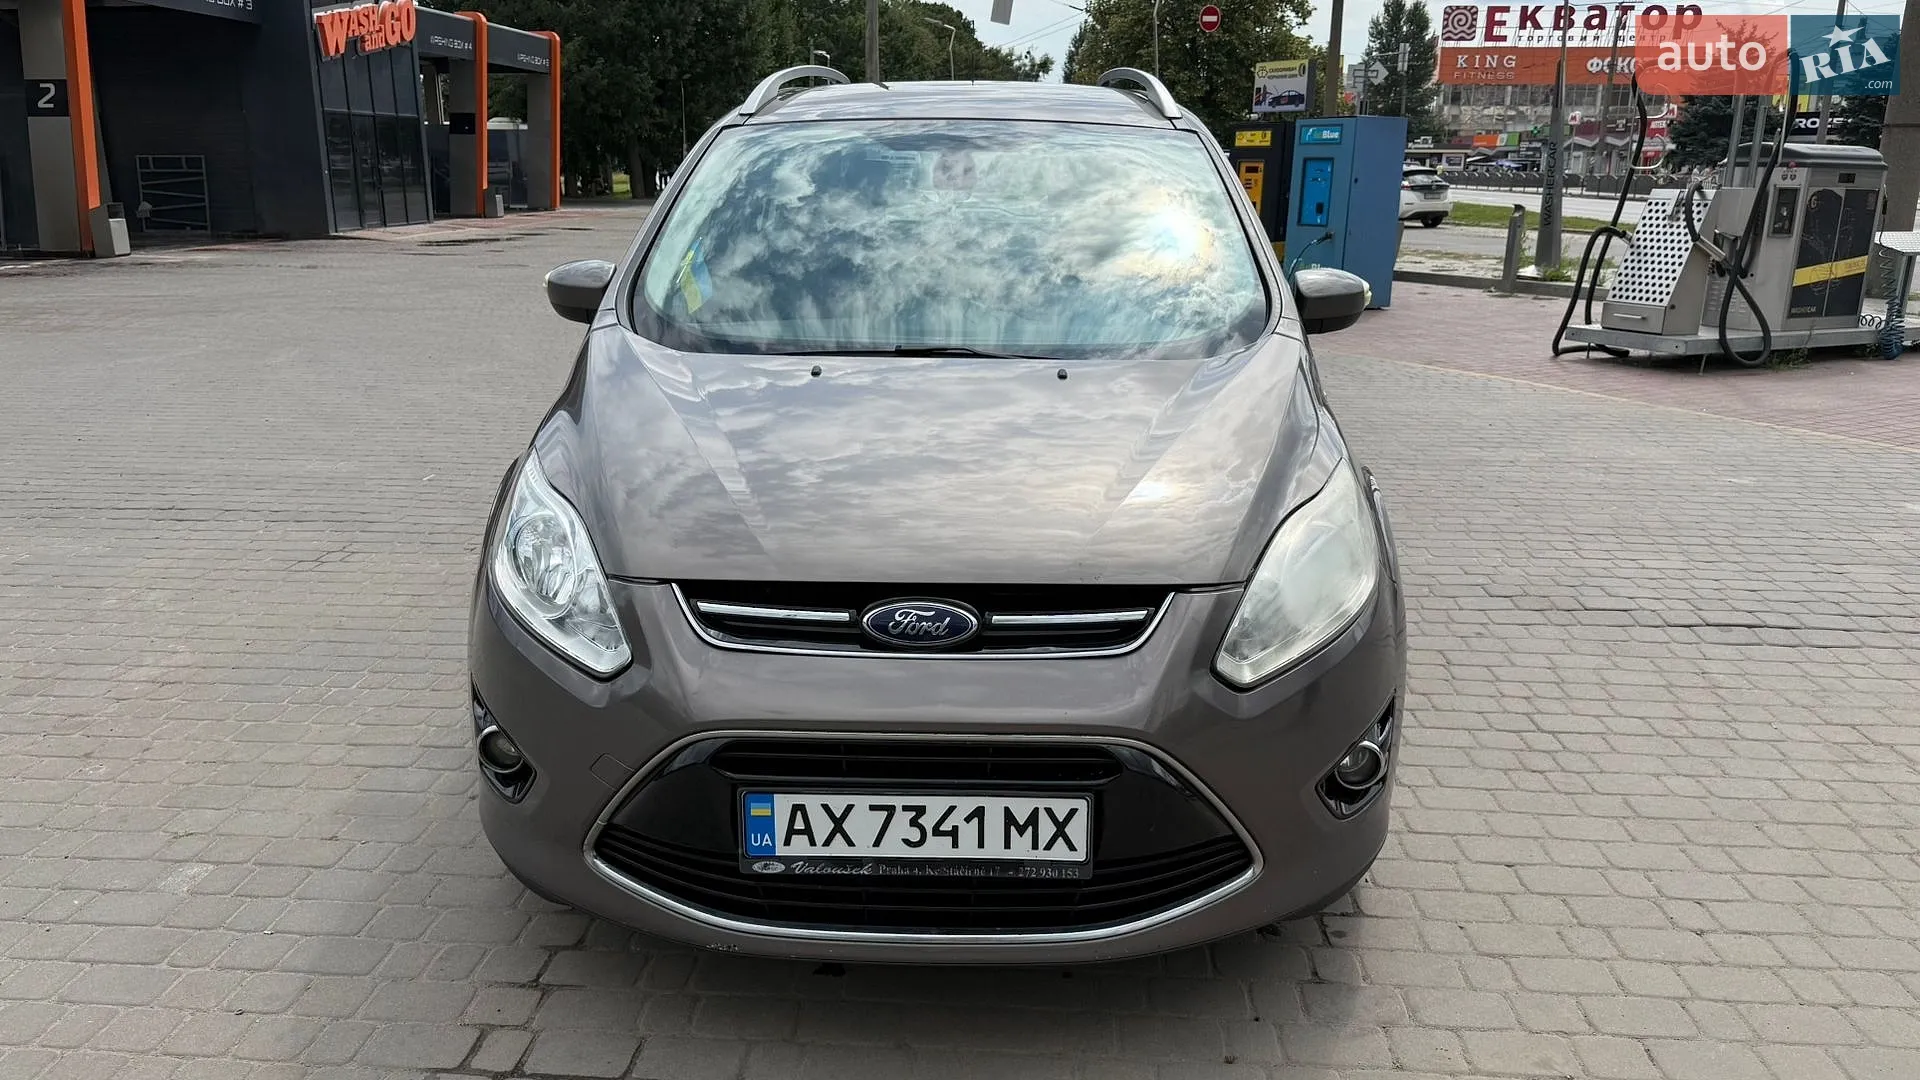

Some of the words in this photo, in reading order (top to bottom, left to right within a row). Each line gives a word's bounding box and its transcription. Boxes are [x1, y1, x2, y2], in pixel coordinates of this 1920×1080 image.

[317, 5, 379, 56] WASH
[384, 0, 416, 46] GO
[364, 24, 386, 51] and
[1456, 55, 1517, 68] KING
[1453, 71, 1515, 80] FITNESS
[37, 83, 56, 108] 2
[1543, 141, 1557, 227] WASHERCAR
[888, 609, 950, 635] Ford
[751, 833, 773, 847] UA
[783, 803, 856, 848] AX
[868, 804, 985, 849] 7341
[1003, 806, 1079, 852] MX
